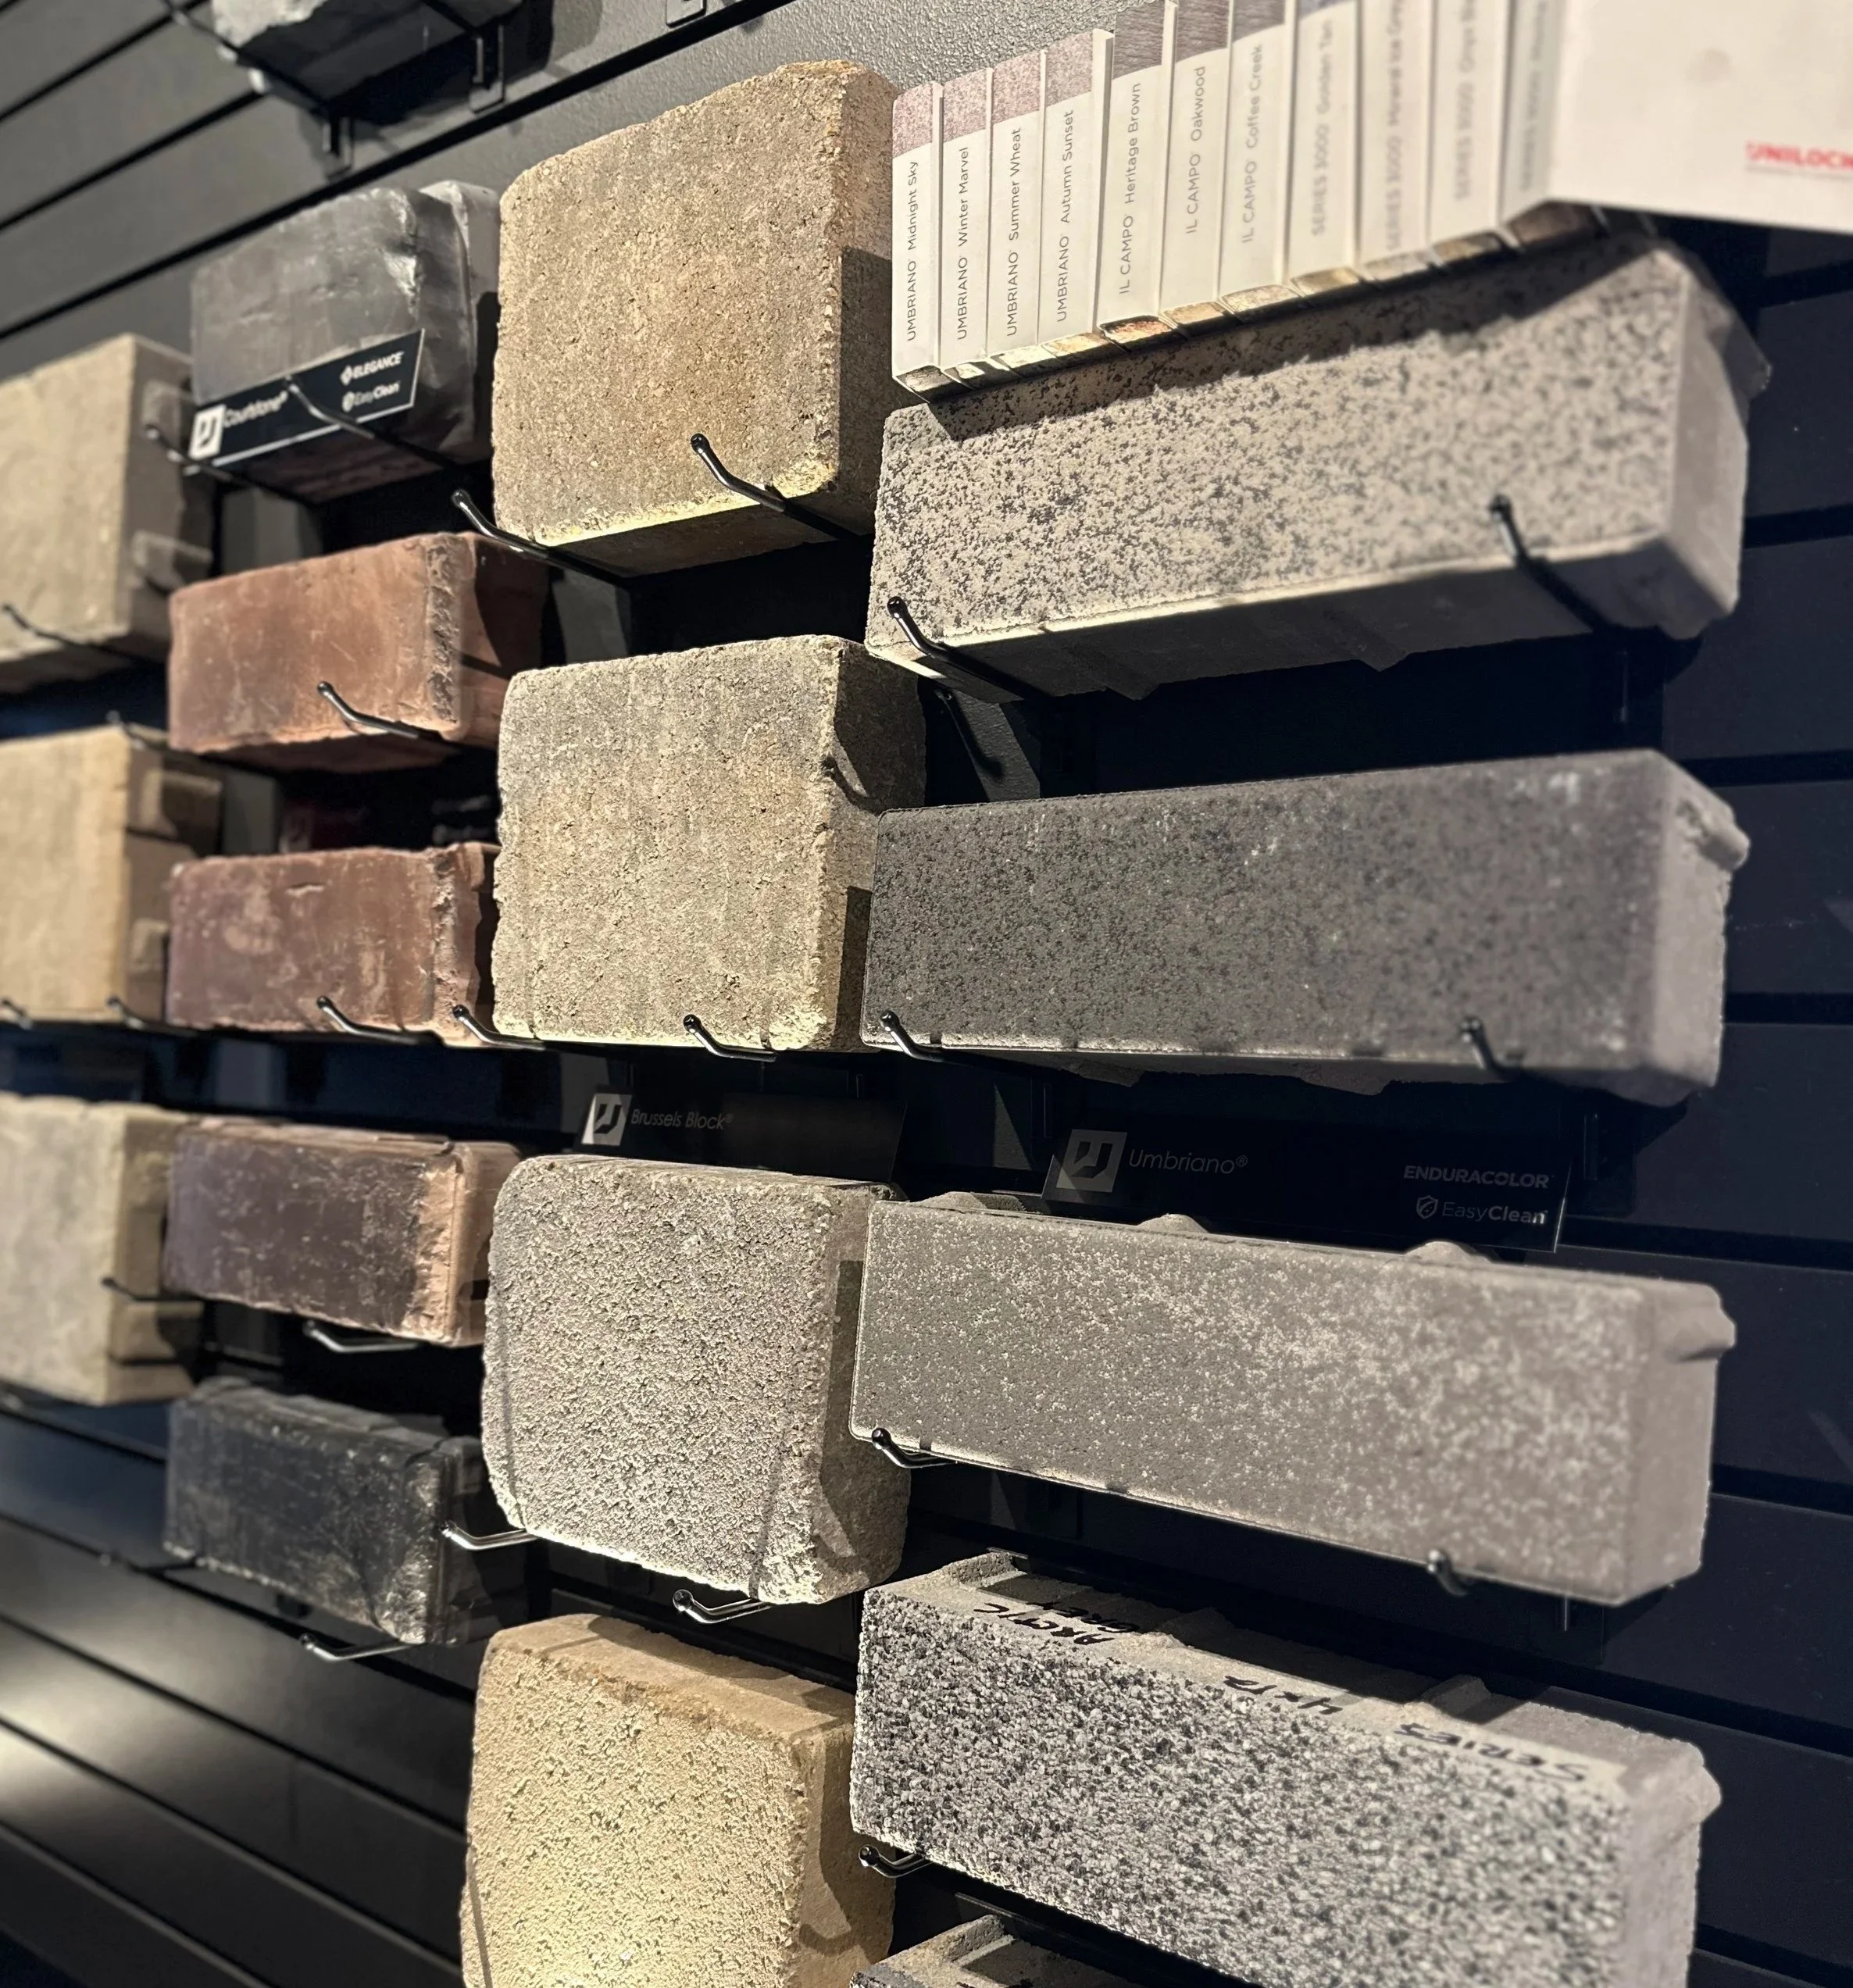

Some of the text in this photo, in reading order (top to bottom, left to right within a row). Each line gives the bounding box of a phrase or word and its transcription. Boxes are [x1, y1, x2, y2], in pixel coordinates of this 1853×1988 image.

[1006, 127, 1022, 336] UMBRIANO Summer Wheat
[1056, 109, 1075, 322] UMBRIANO Autumn Sunset
[1119, 82, 1141, 294] IL CAMPO Heritage Brown
[1185, 65, 1206, 234] IL CAMPO Oakwood
[1241, 43, 1263, 243] IL CAMPO Coffee Creek
[1310, 174, 1328, 236] SERIES
[906, 160, 919, 341] UMBRIANO Midnight Sky
[957, 146, 969, 340] UMBRIANO Winter Marvel
[630, 1108, 684, 1128] Brussels
[1403, 1165, 1551, 1189] ENDURACOLOR
[1441, 1201, 1548, 1225] EasyClean
